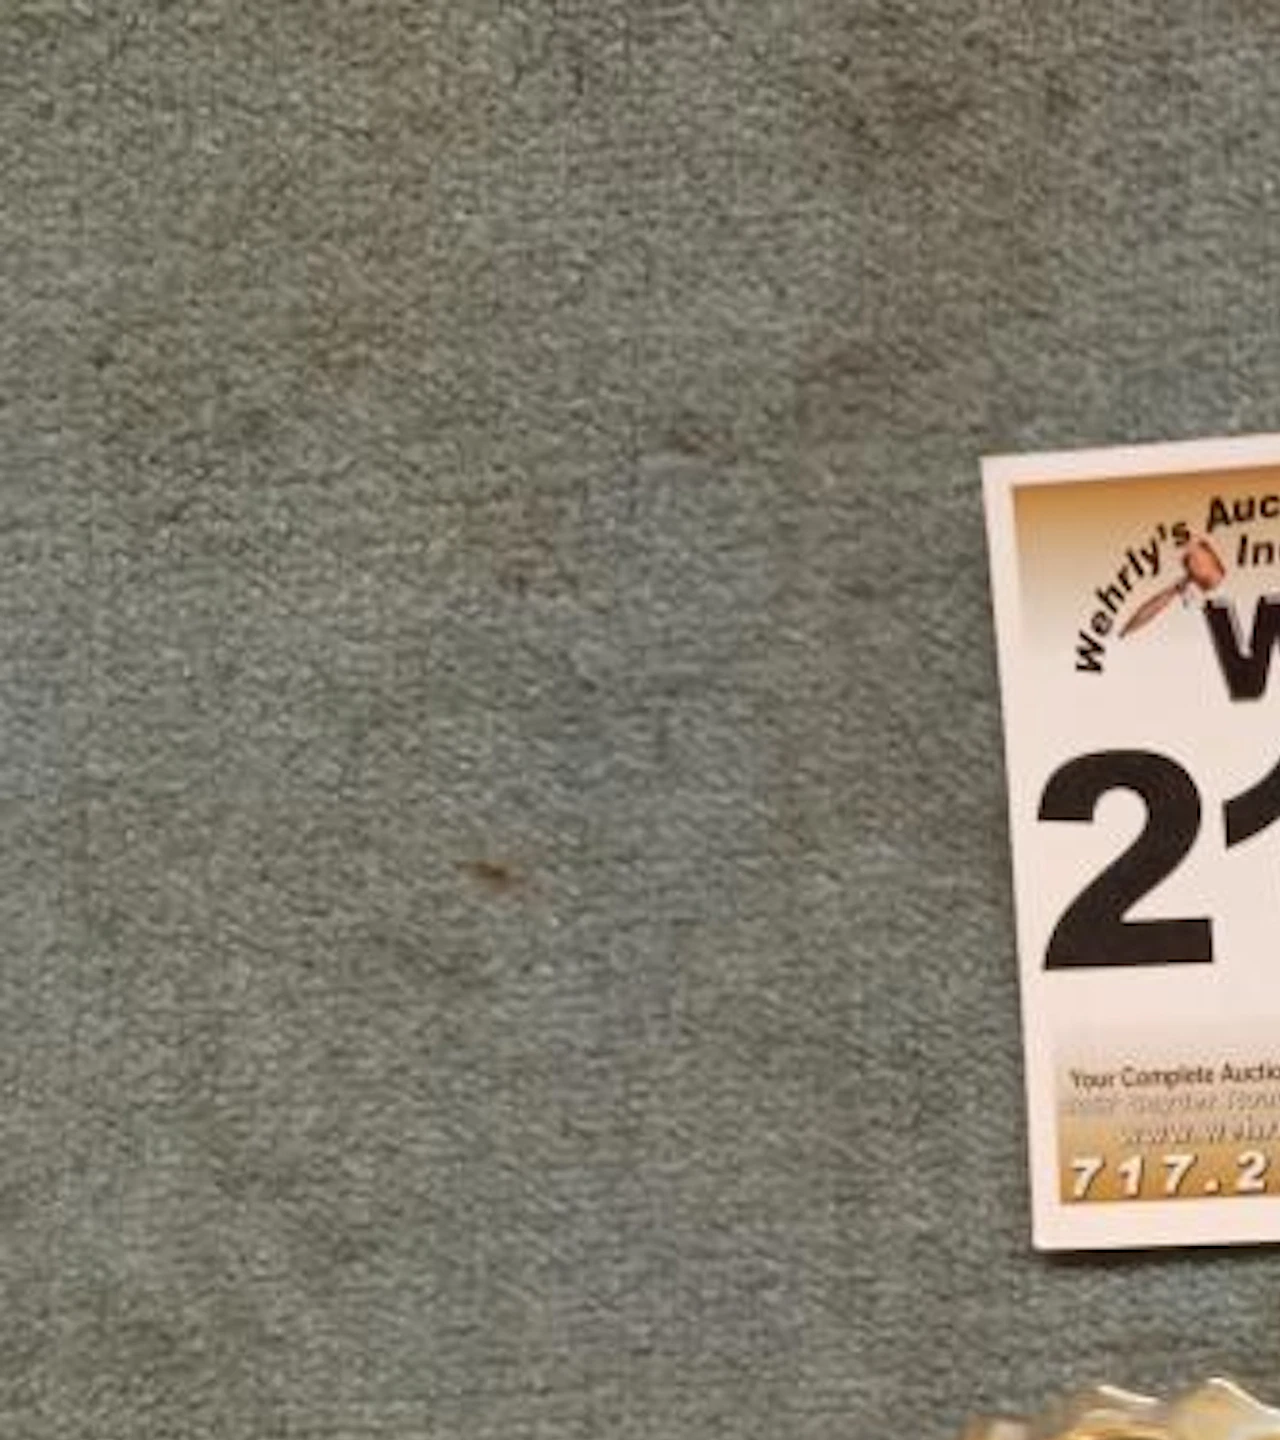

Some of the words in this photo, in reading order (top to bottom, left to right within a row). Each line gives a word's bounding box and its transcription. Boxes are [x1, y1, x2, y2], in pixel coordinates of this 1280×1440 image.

[1075, 520, 1191, 674] Wehrly's
[1070, 1069, 1116, 1090] Your
[1120, 1064, 1214, 1090] Complete
